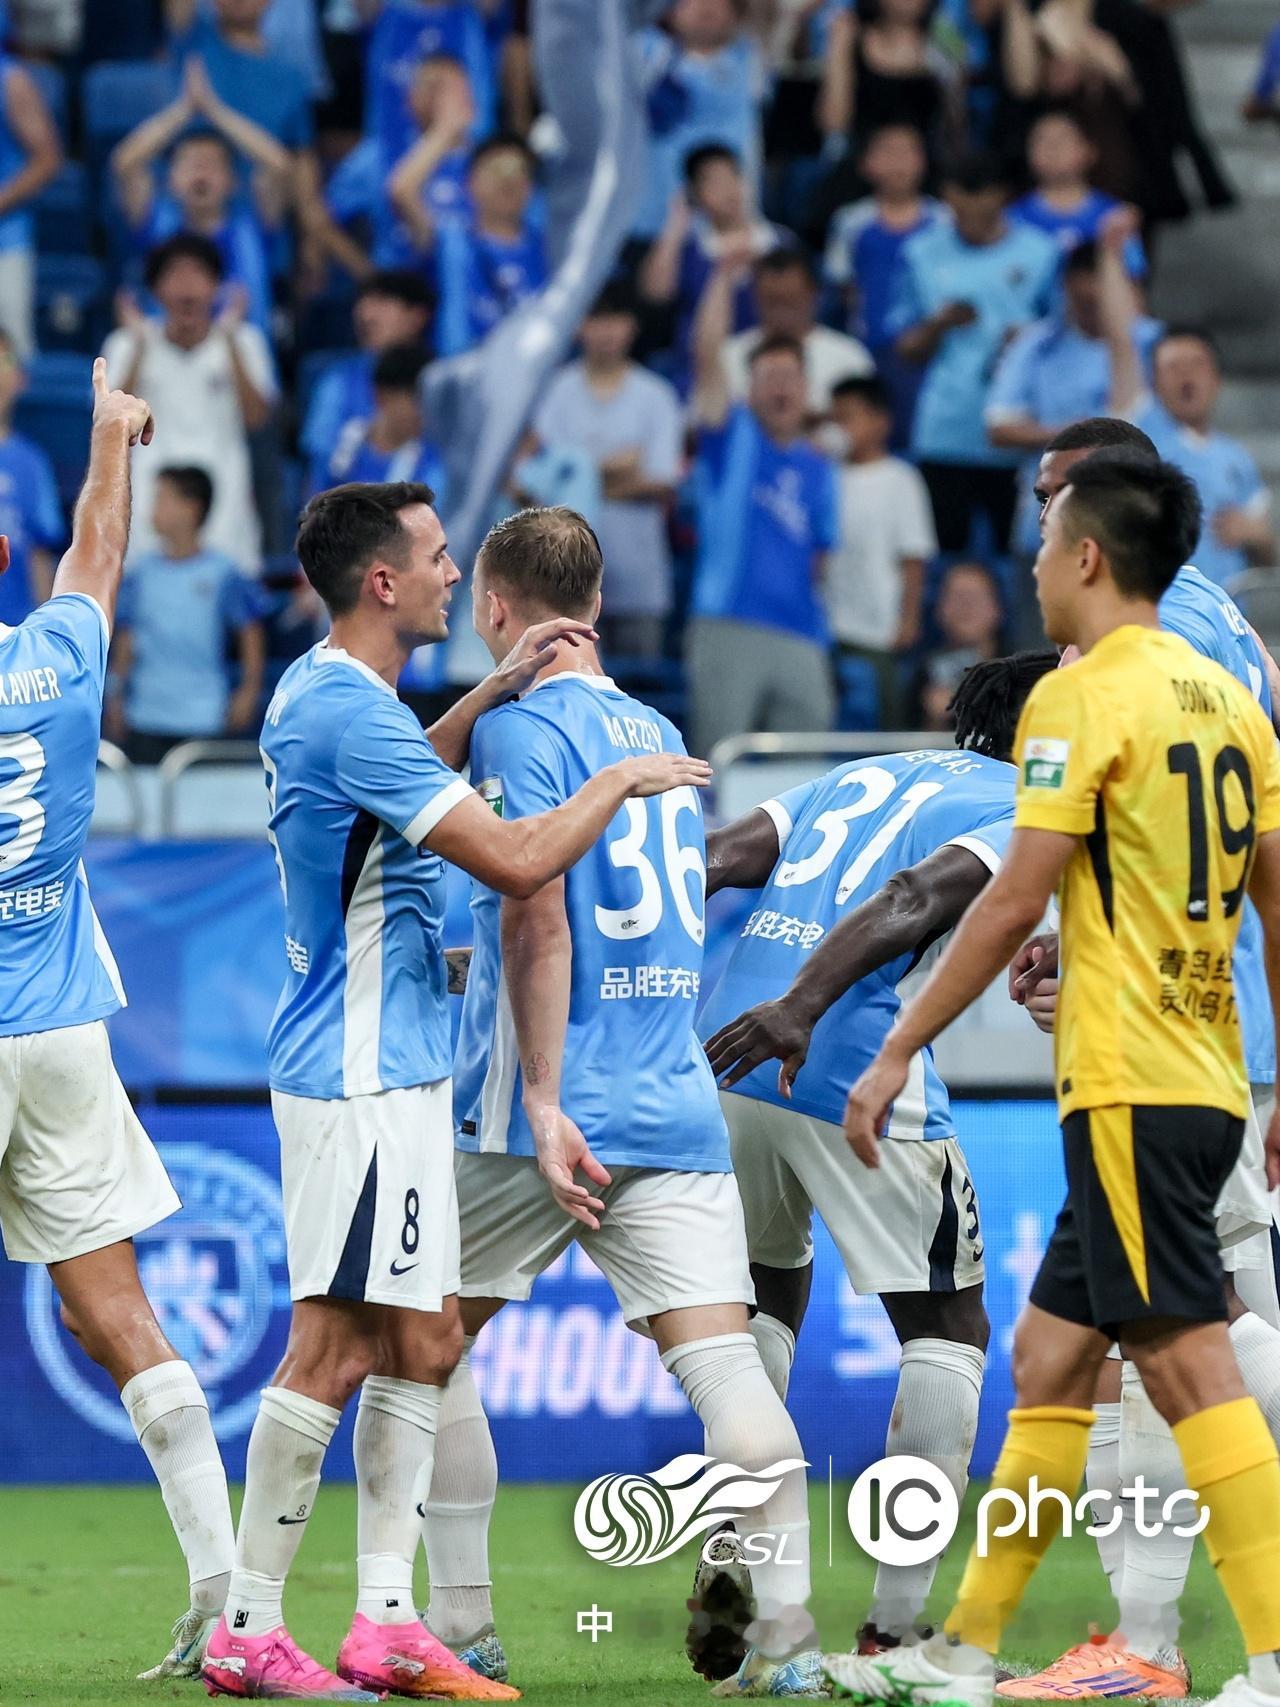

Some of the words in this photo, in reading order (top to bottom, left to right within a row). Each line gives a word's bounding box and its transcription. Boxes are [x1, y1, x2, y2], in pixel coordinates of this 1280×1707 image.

[594, 785, 707, 947] 36
[774, 765, 945, 906] 31
[1166, 740, 1257, 923] 19
[740, 909, 828, 951] 品胜充电
[401, 1187, 420, 1255] 8
[295, 1503, 308, 1518] 8
